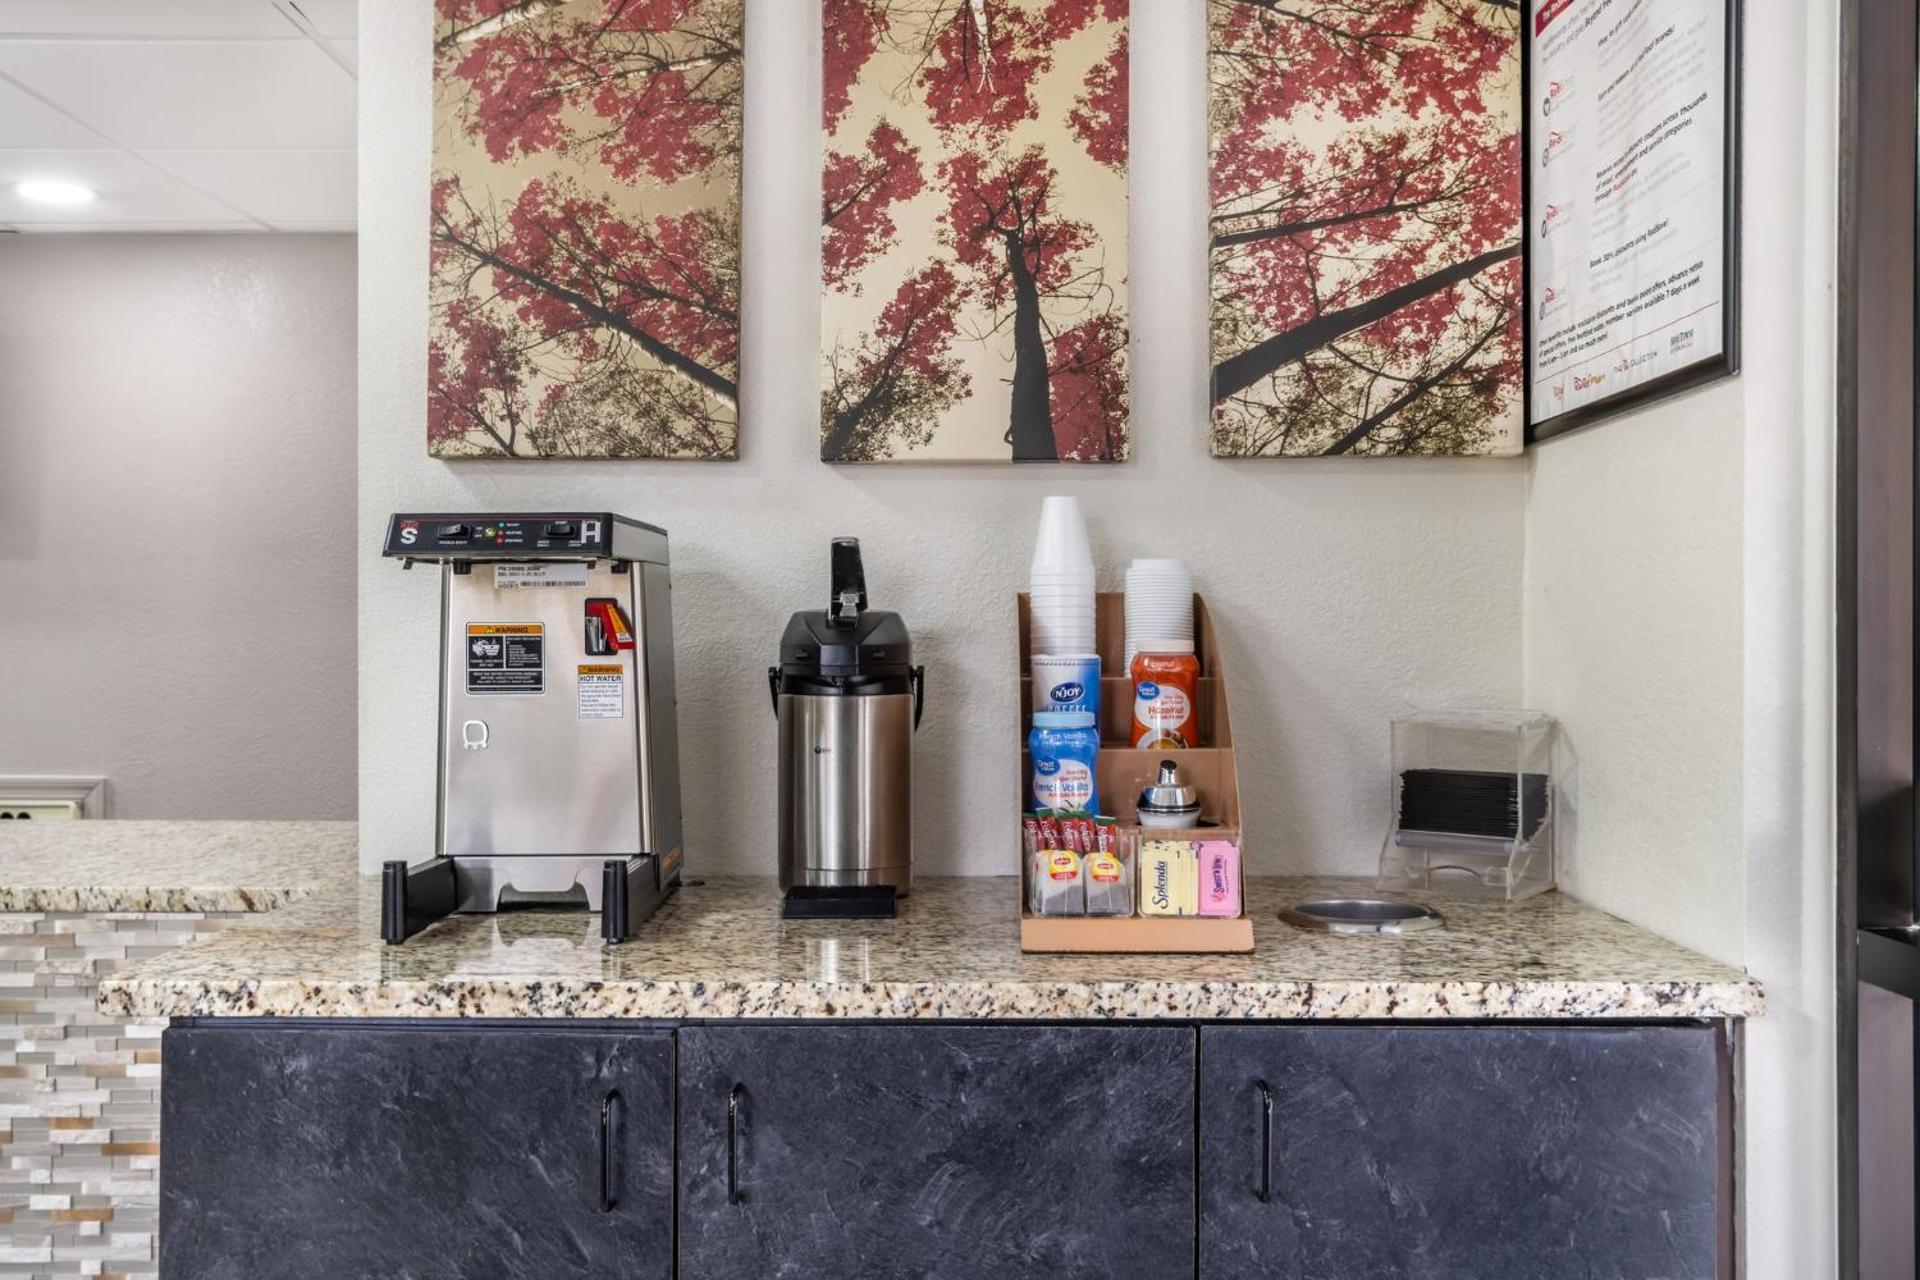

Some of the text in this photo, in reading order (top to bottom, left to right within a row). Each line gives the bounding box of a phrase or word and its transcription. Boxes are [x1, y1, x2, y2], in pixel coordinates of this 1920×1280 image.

[400, 527, 418, 545] S
[581, 520, 601, 544] H
[495, 626, 529, 634] WARNING
[1148, 705, 1185, 715] Hazelnut
[1152, 860, 1169, 909] Splenda
